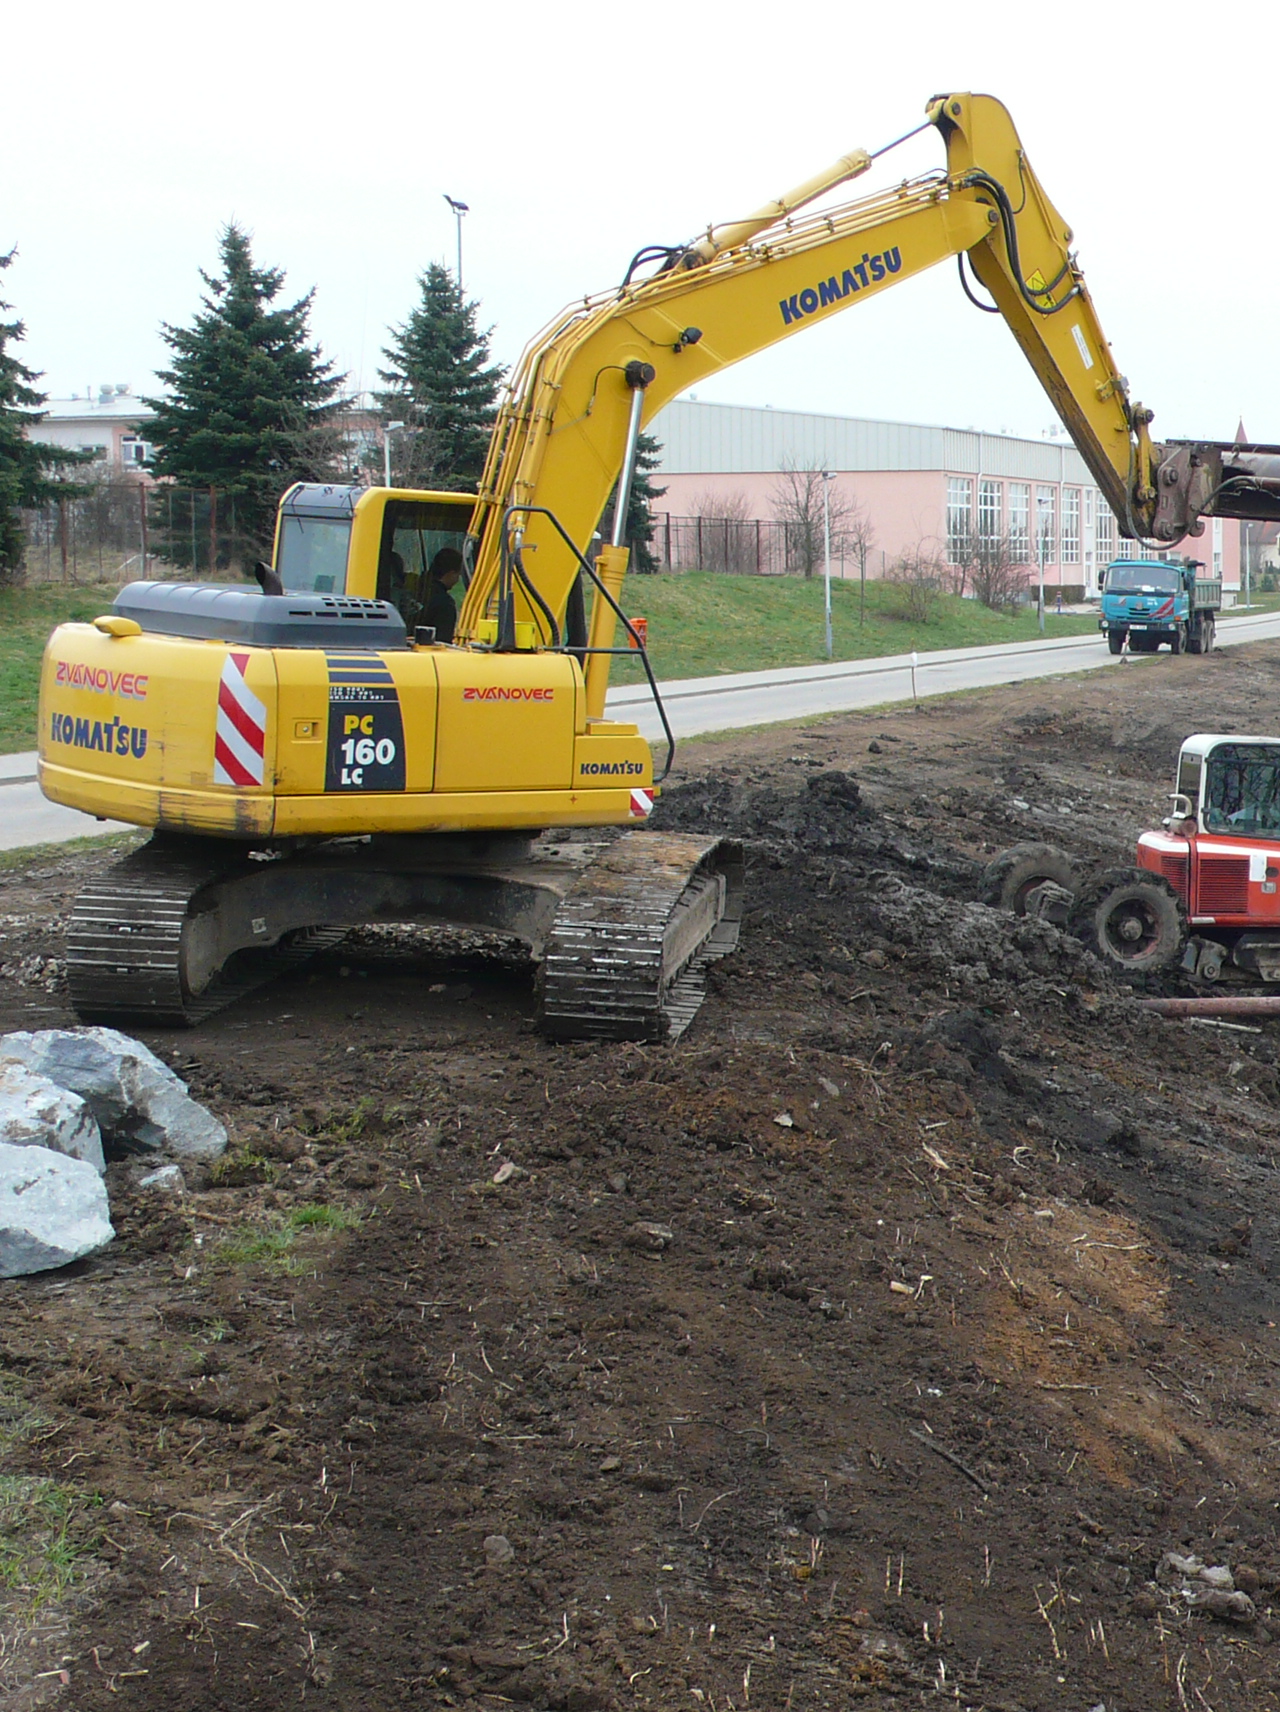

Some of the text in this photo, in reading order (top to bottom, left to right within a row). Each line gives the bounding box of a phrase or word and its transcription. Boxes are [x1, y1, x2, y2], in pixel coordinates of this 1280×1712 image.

[779, 246, 902, 325] KOMATSU
[51, 712, 147, 759] KOMATSU
[344, 715, 374, 735] PC
[341, 738, 395, 765] 160
[341, 768, 363, 784] LC
[580, 760, 643, 774] KOMATSU
